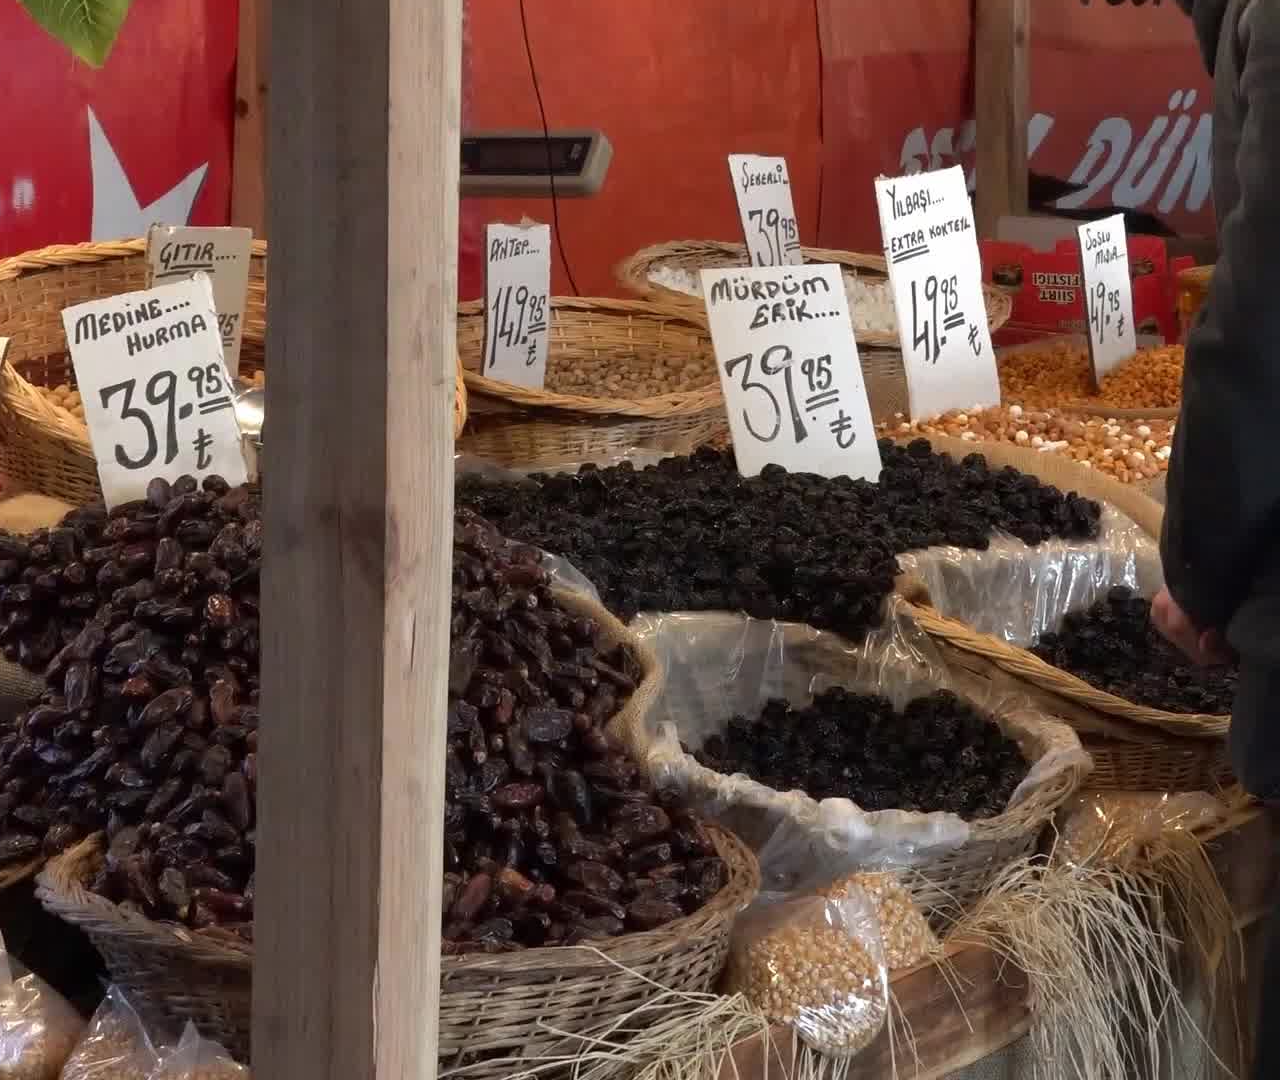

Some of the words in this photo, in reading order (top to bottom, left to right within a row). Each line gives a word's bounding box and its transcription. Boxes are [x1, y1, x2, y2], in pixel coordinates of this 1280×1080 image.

[891, 231, 926, 253] EXTRA
[710, 275, 829, 305] MÜRDÜM
[126, 314, 208, 357] HURMA
